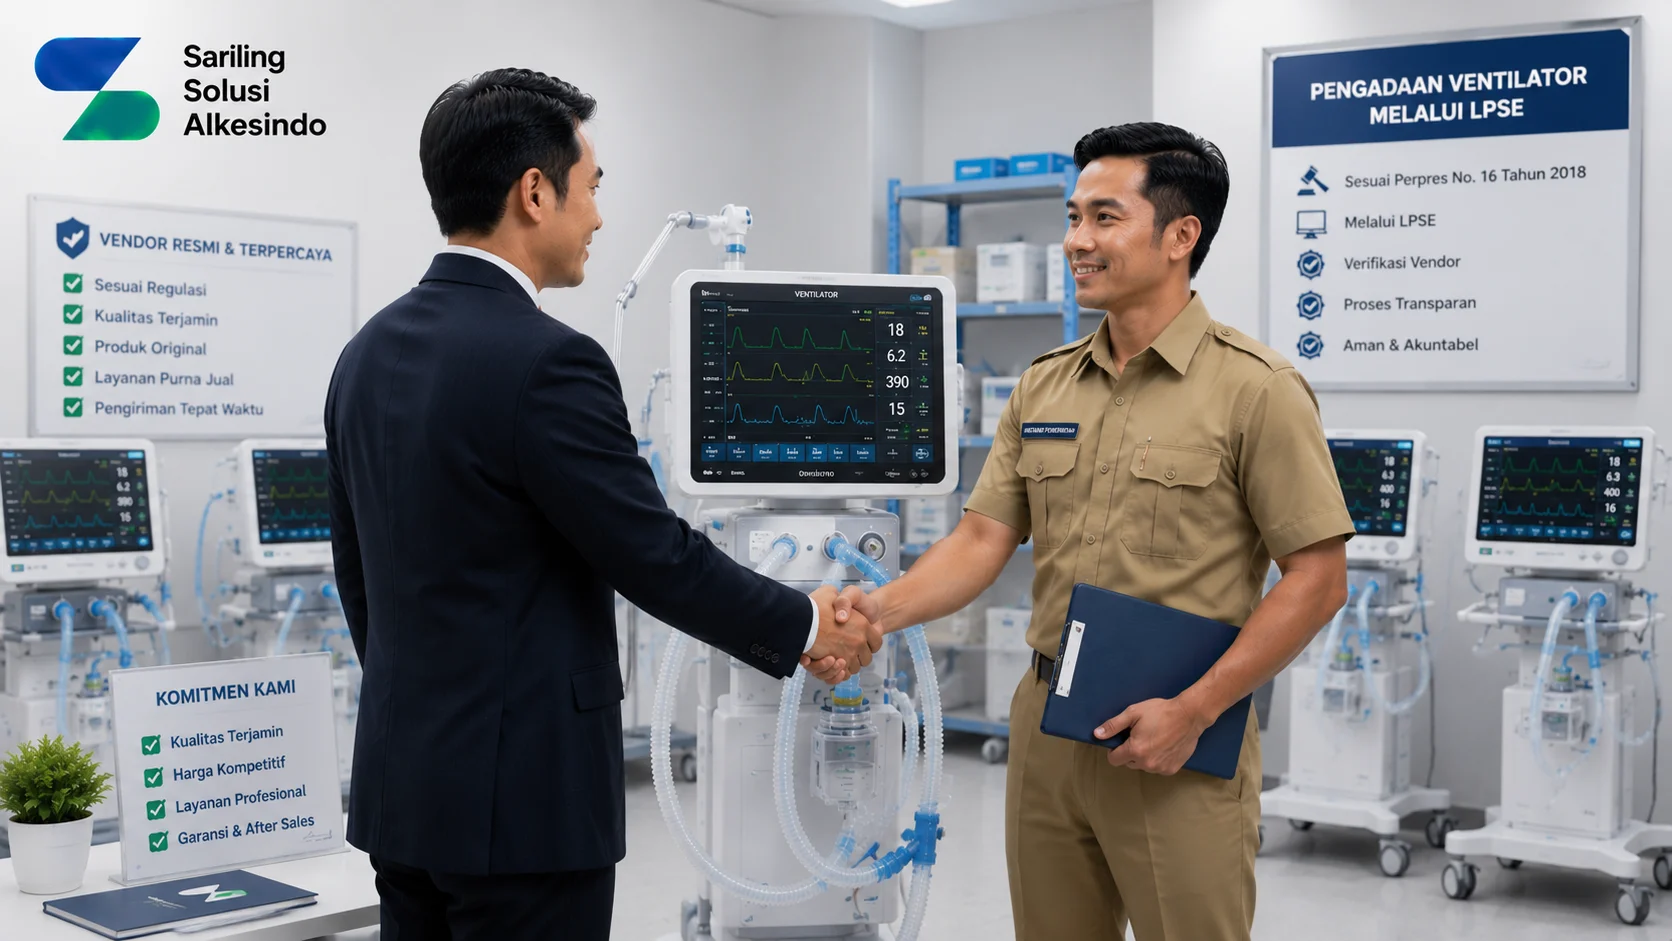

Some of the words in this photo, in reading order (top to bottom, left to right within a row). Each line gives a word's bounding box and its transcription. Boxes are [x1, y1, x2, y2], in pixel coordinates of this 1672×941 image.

[1311, 75, 1442, 100] PENGADAAN
[1449, 67, 1587, 92] VENTILATOR
[1370, 102, 1462, 124] MELALUI
[1471, 98, 1523, 119] LPSE
[1345, 174, 1390, 188] Sesuai
[1395, 174, 1448, 188] Perpres
[1453, 172, 1475, 183] No.
[1482, 170, 1497, 182] 16
[1502, 168, 1545, 181] Tahun
[1551, 166, 1586, 179] 2018
[1345, 216, 1394, 228] Melalui
[1400, 214, 1435, 227] LPSE
[100, 233, 167, 250] VENDOR
[173, 238, 219, 253] RESMI
[225, 242, 234, 254] &
[240, 243, 332, 261] TERPERCAYA
[1345, 257, 1406, 269] Verifikasi
[1411, 255, 1460, 268] Vendor
[95, 278, 142, 292] Sesuai
[148, 281, 206, 297] Regulasi
[1345, 298, 1391, 310] Proses
[1396, 297, 1476, 312] Transparan
[95, 309, 153, 324] Kualitas
[158, 312, 217, 328] Terjamin
[889, 323, 903, 336] 18
[96, 340, 146, 353] Produk
[151, 342, 206, 358] Original
[1344, 340, 1384, 351] Aman
[1389, 339, 1399, 351] &
[1404, 338, 1478, 350] Akuntabel
[888, 349, 905, 361] 6.2
[95, 371, 155, 387] Layanan
[160, 372, 201, 385] Purna
[206, 374, 233, 385] Jual
[886, 376, 909, 388] 390
[96, 402, 175, 418] Pengiriman
[180, 403, 217, 417] Tepat
[222, 404, 263, 415] Waktu
[890, 403, 904, 415] 15
[1609, 457, 1620, 466] 18
[1606, 472, 1620, 481] 6.3
[1604, 488, 1620, 496] 400
[1605, 503, 1616, 513] 16
[157, 684, 248, 706] KOMITMEN
[255, 680, 295, 696] KAMI
[171, 733, 224, 748] Kualitas
[228, 726, 283, 743] Terjamin
[174, 768, 213, 781] Harga
[218, 756, 285, 775] Kompetitif
[176, 798, 231, 814] Layanan
[235, 785, 306, 805] Profesional
[178, 826, 228, 844] Garansi
[233, 825, 241, 837] &
[246, 821, 277, 835] After
[281, 816, 314, 829] Sales
